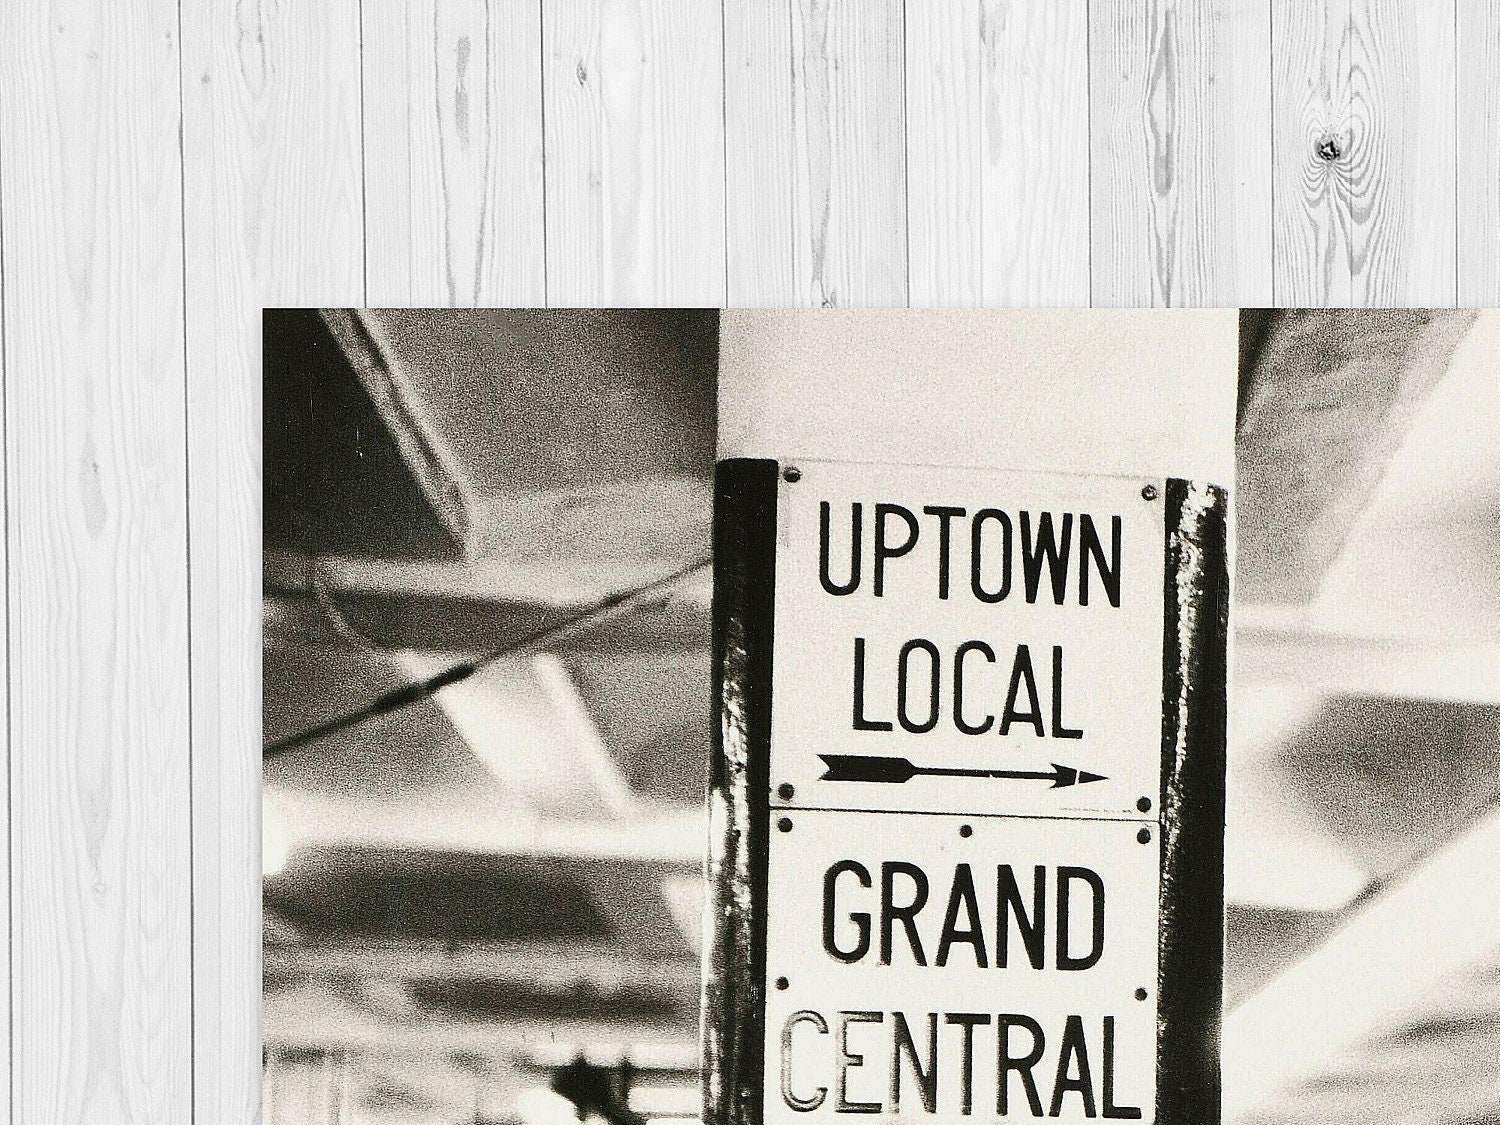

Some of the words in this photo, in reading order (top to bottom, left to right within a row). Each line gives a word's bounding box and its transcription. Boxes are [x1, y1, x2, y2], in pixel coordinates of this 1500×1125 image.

[819, 501, 1122, 608] UPTOWN
[852, 637, 1084, 740] LOCAL
[822, 859, 1106, 971] GRAND
[780, 1009, 1143, 1120] CENTRAL
